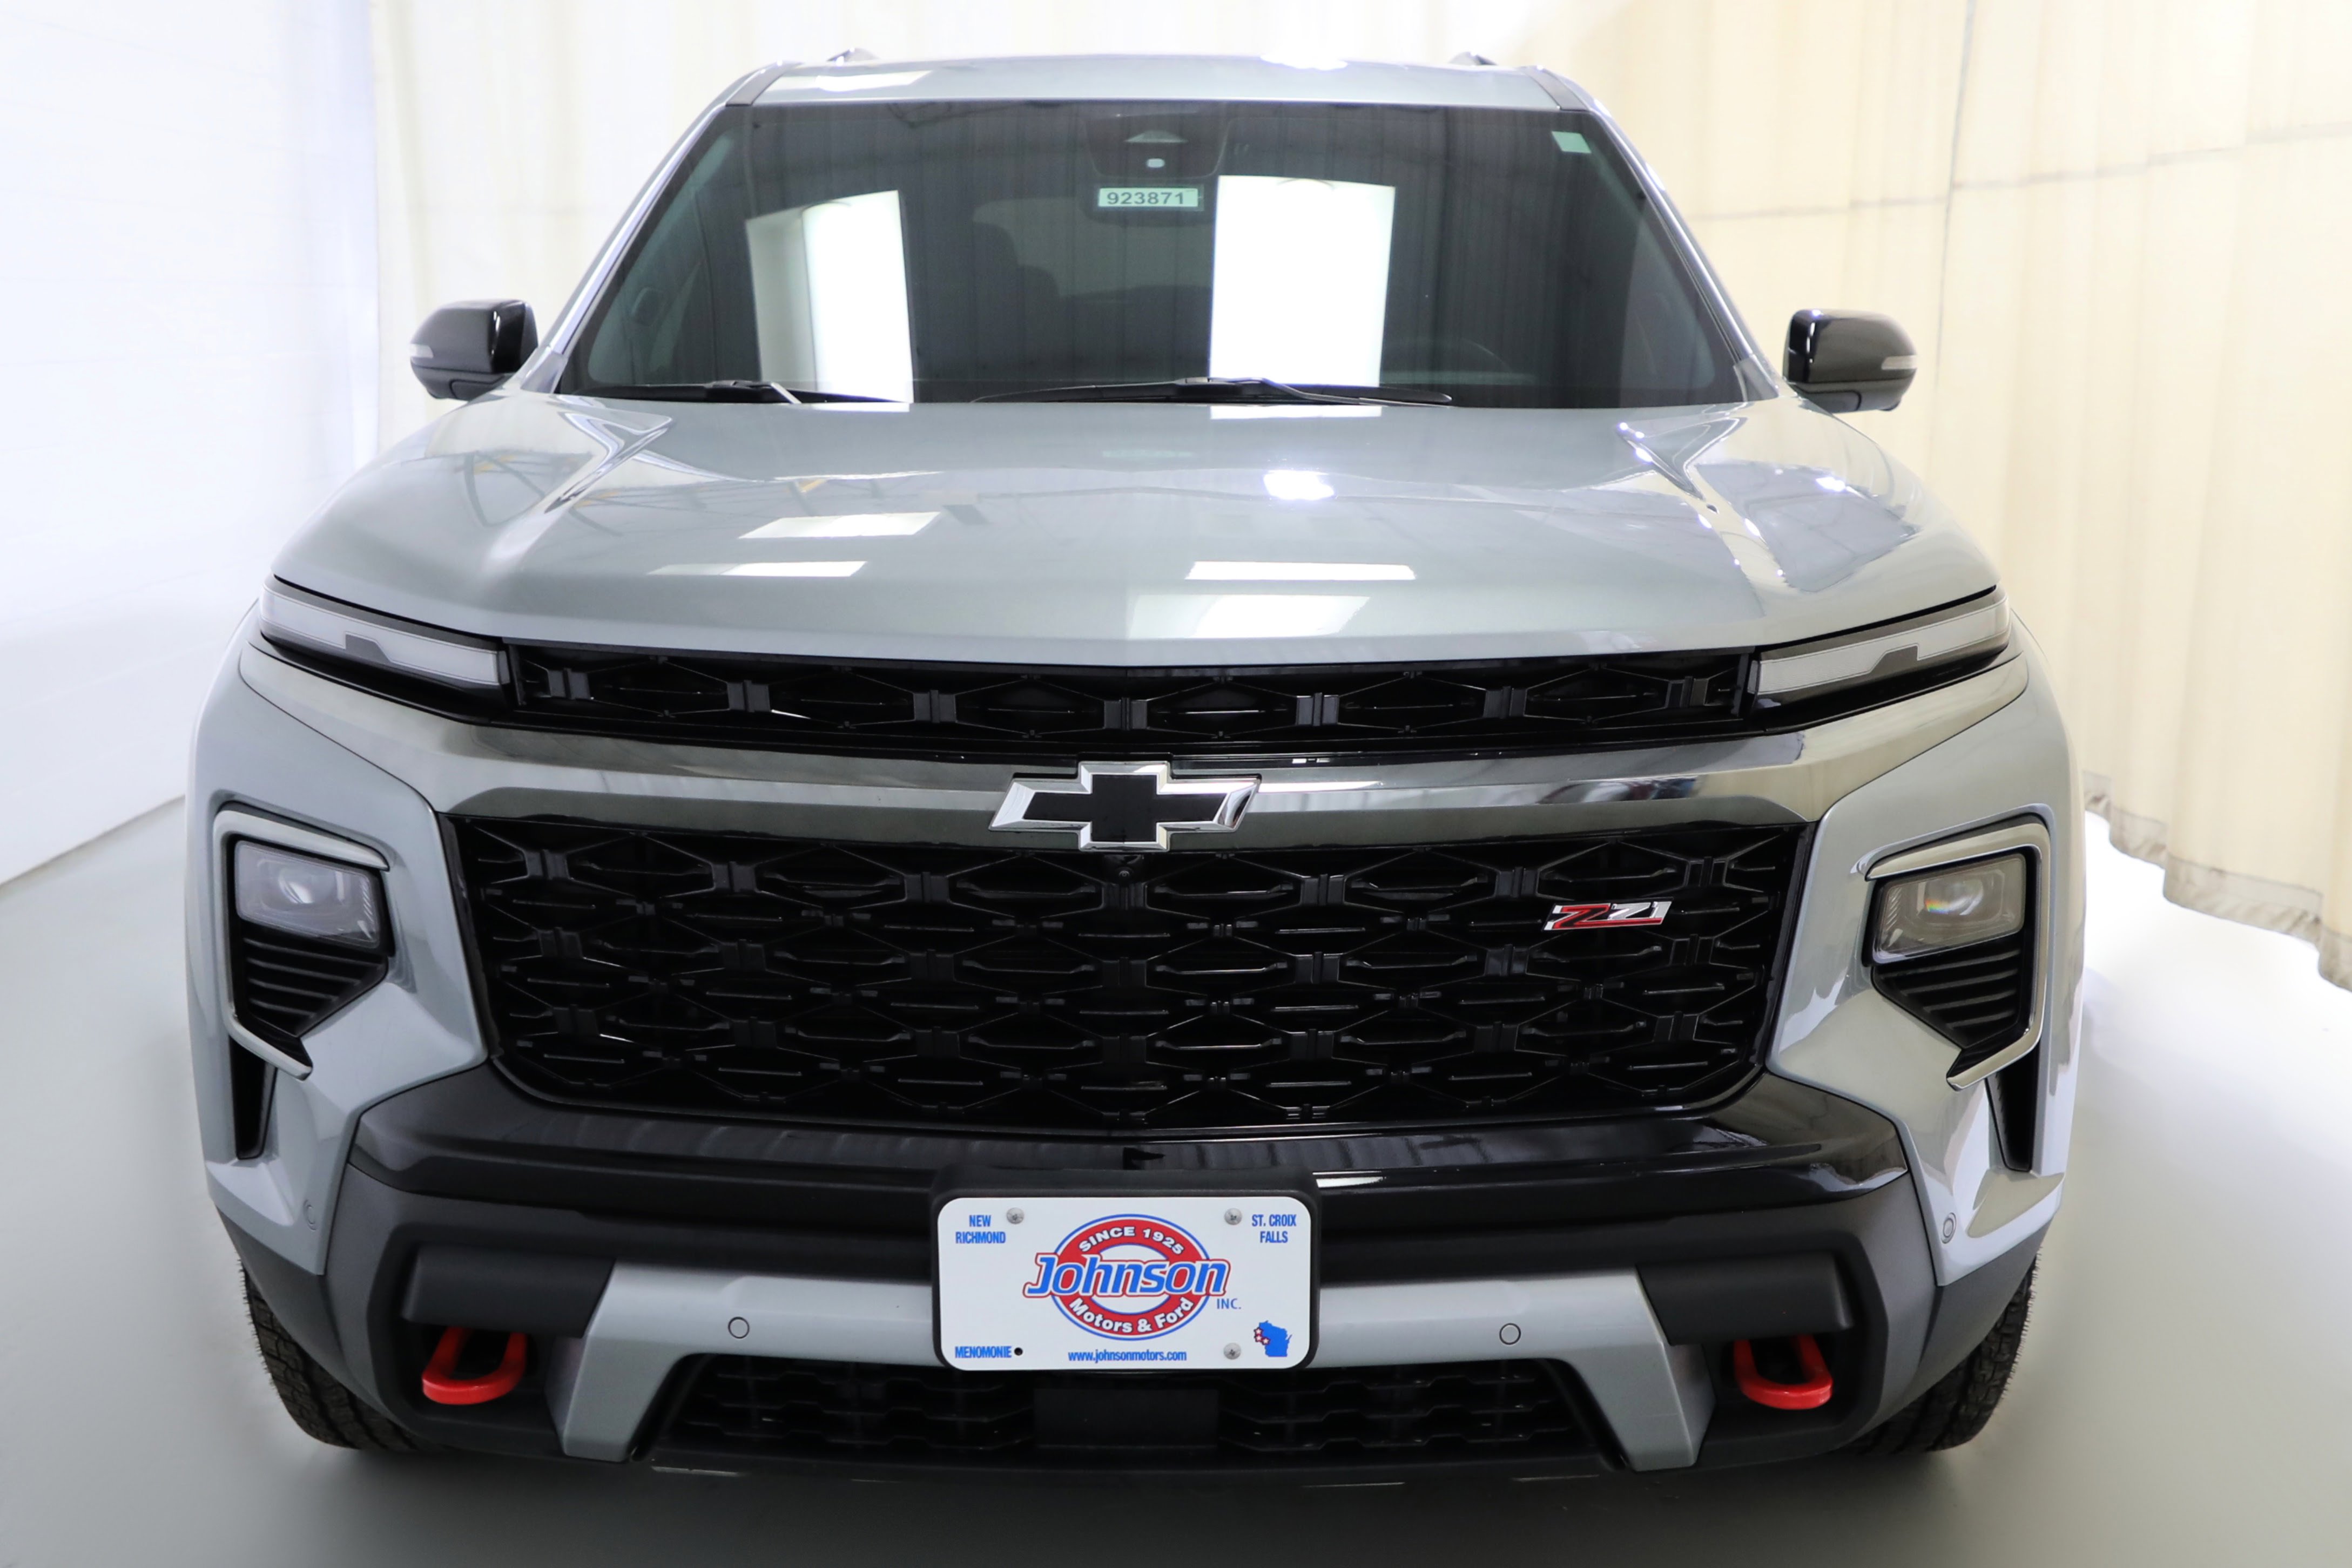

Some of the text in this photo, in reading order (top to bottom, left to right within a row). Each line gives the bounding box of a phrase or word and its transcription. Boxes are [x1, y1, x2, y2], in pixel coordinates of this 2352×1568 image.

[1107, 192, 1184, 205] 923871
[1544, 901, 1672, 930] Z71
[969, 1214, 992, 1227] NEW
[1252, 1214, 1297, 1227] ST. CROIX
[955, 1231, 1006, 1243] RICHMOND
[1079, 1226, 1185, 1255] SINCE 1925
[1260, 1231, 1289, 1243] FALLS
[1025, 1255, 1229, 1296] Johnson
[1216, 1298, 1242, 1309] INC.
[1068, 1296, 1194, 1333] Motors & Ford
[955, 1346, 1012, 1359] MENOMONIE
[1068, 1349, 1187, 1364] www.johnsonmotors.com
